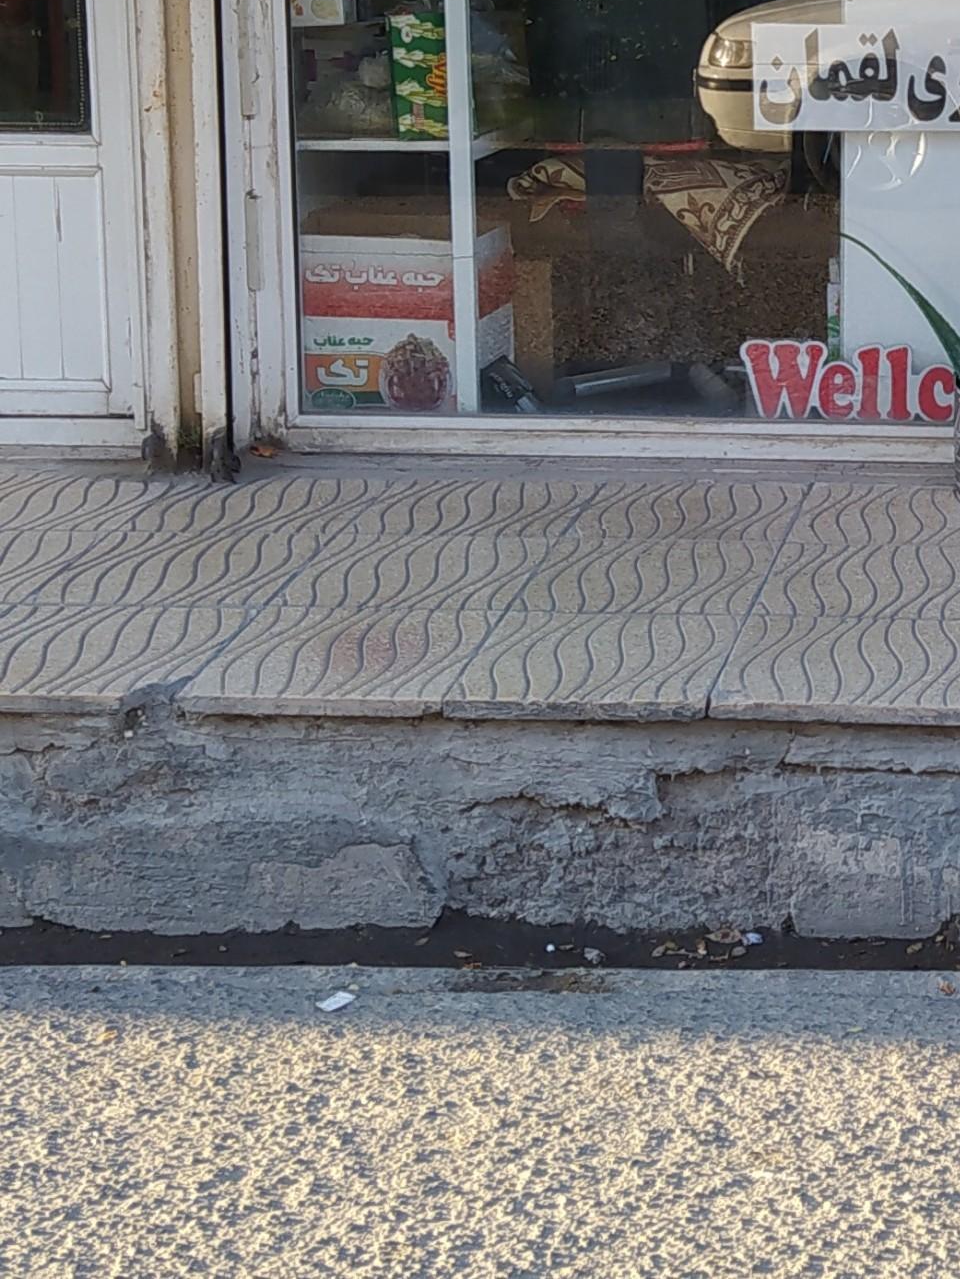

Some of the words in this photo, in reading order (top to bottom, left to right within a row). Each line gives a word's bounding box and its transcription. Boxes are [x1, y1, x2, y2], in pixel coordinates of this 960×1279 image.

[758, 27, 900, 125] لقمان
[305, 264, 342, 284] تک
[344, 264, 398, 290] عناب
[316, 358, 369, 387] تک
